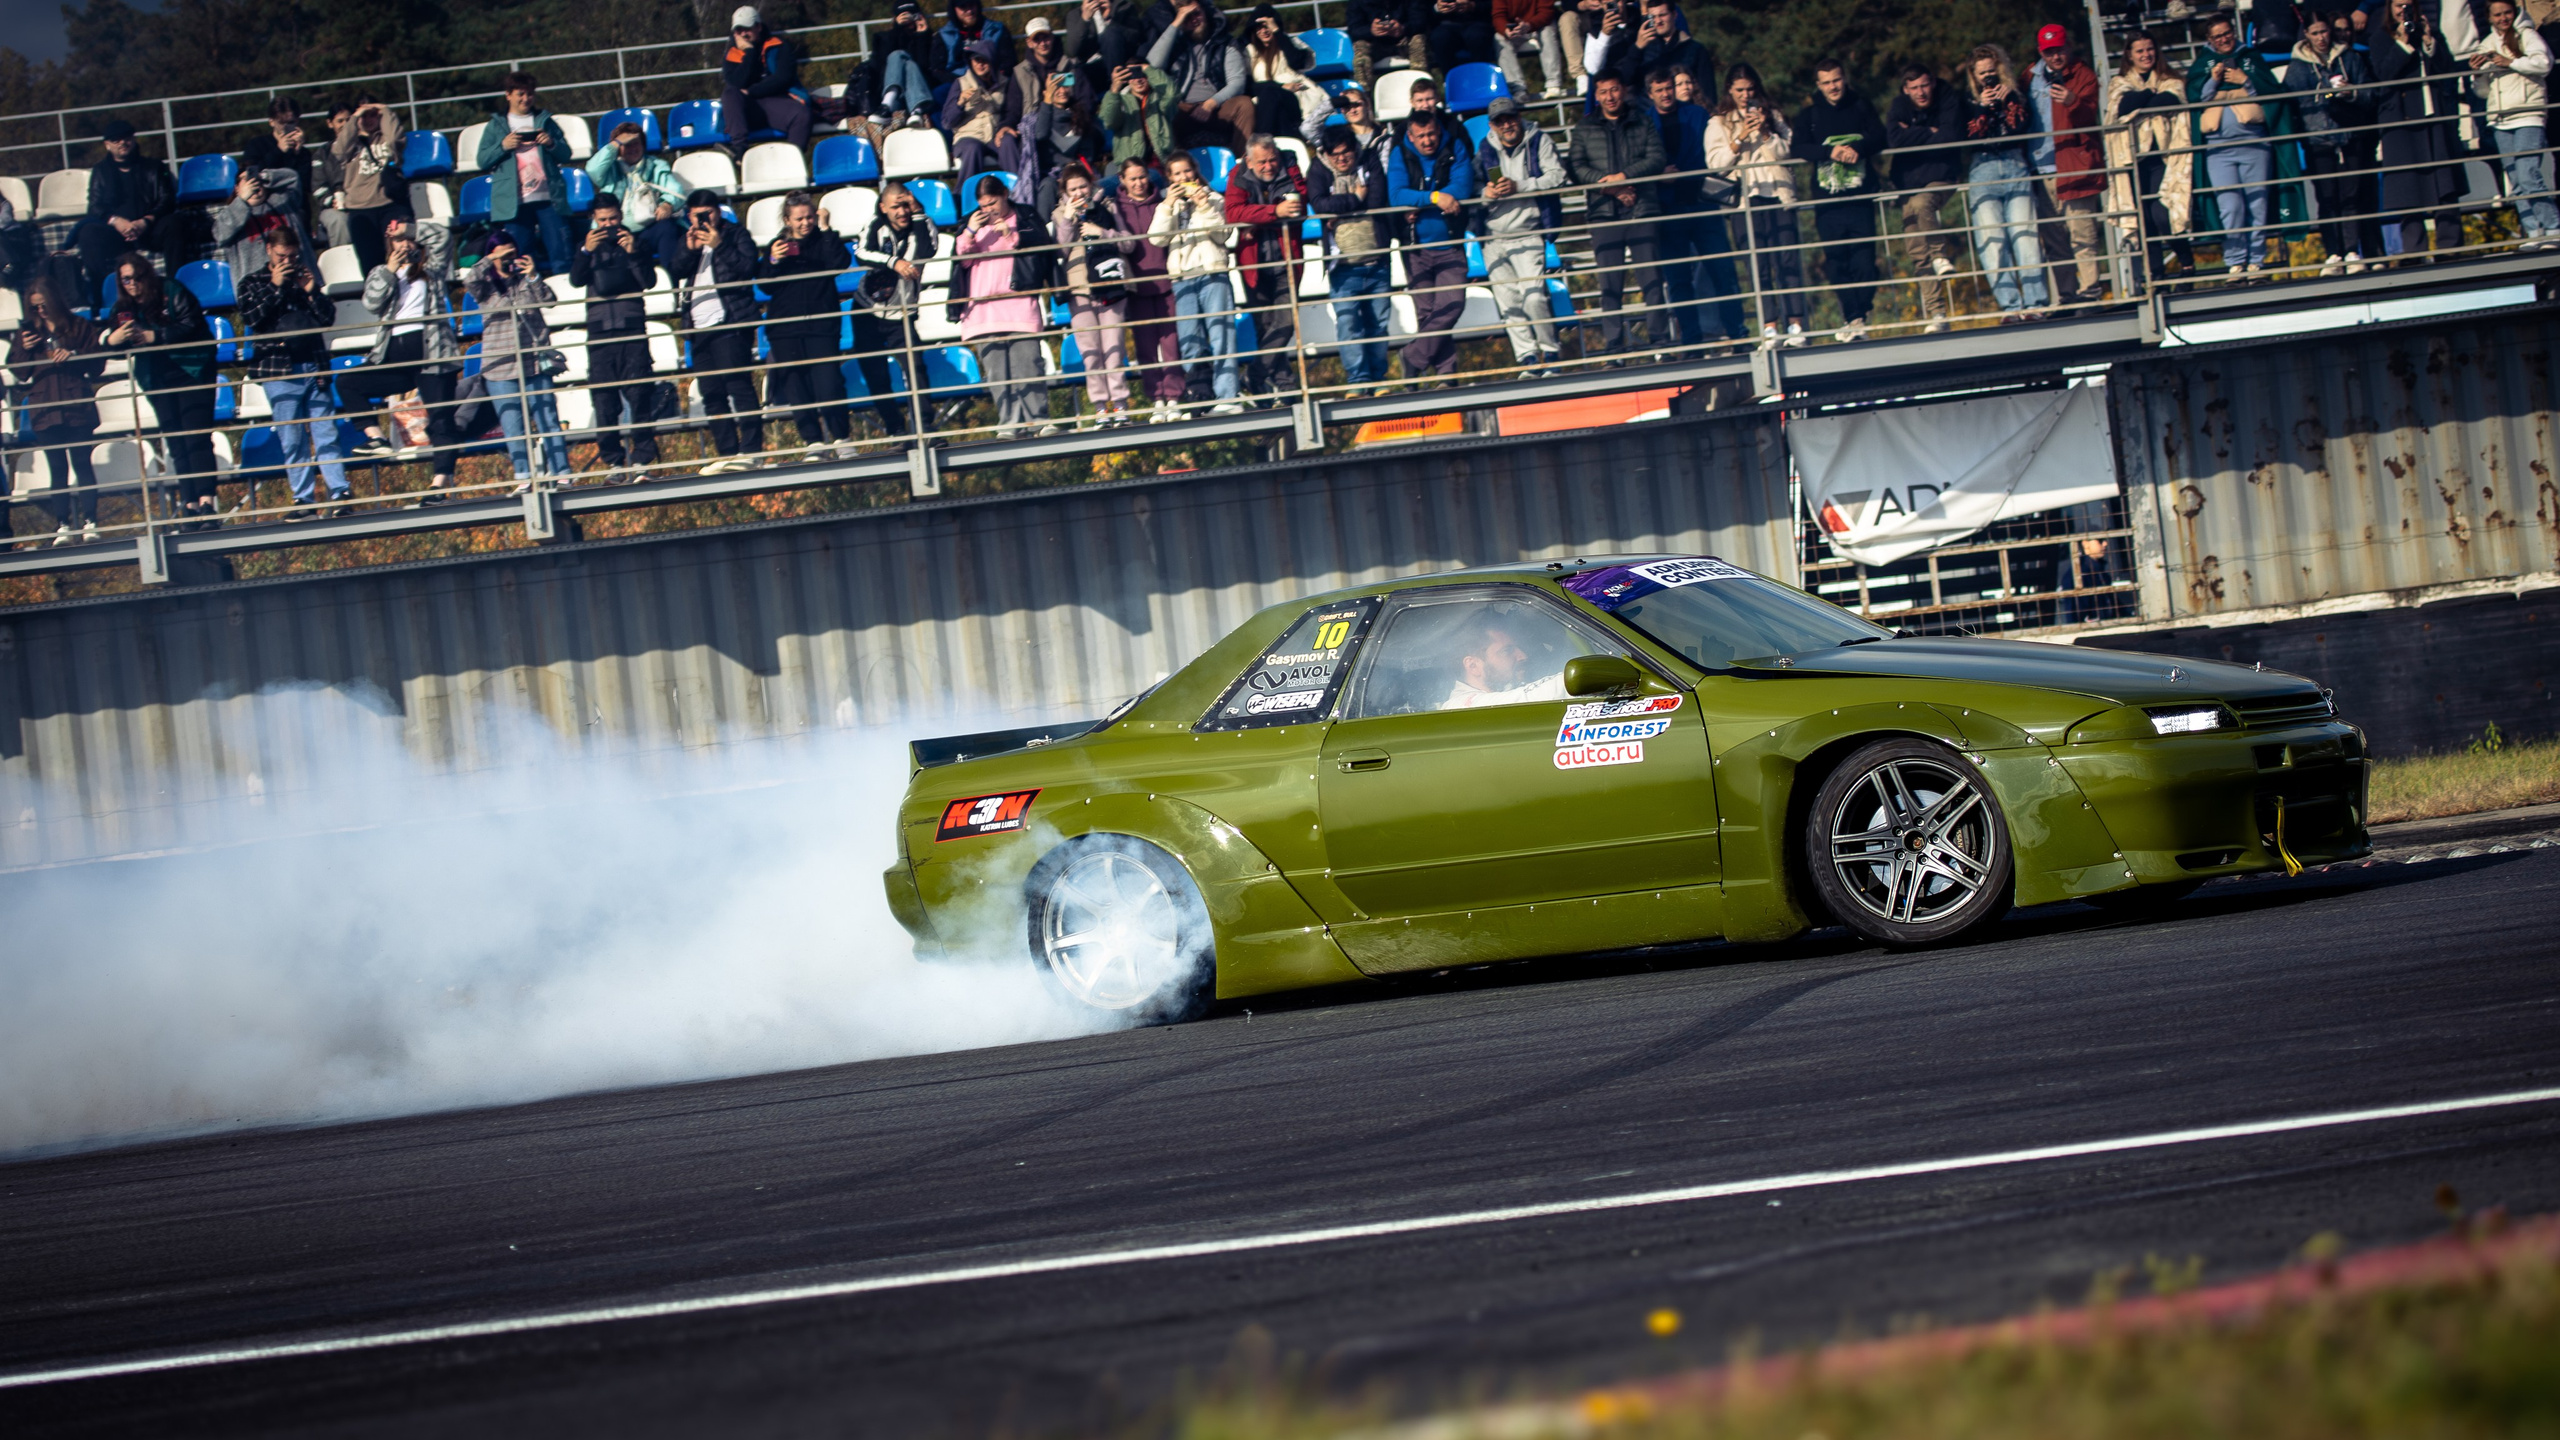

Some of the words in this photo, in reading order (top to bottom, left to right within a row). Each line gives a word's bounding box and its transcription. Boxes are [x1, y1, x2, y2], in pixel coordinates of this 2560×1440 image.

[1873, 482, 1952, 526] AD
[1645, 562, 1686, 576] ADM
[1660, 567, 1745, 583] CONTEST
[1312, 620, 1350, 650] 10
[1266, 651, 1325, 666] Gasymov
[1327, 649, 1340, 660] R.
[1289, 665, 1331, 680] AVOL
[1287, 679, 1315, 688] MOTOR
[1263, 692, 1324, 711] WISEFAB
[1560, 721, 1667, 743] KINFOREST
[1557, 744, 1640, 766] auto.ru
[943, 794, 1031, 829] K3N
